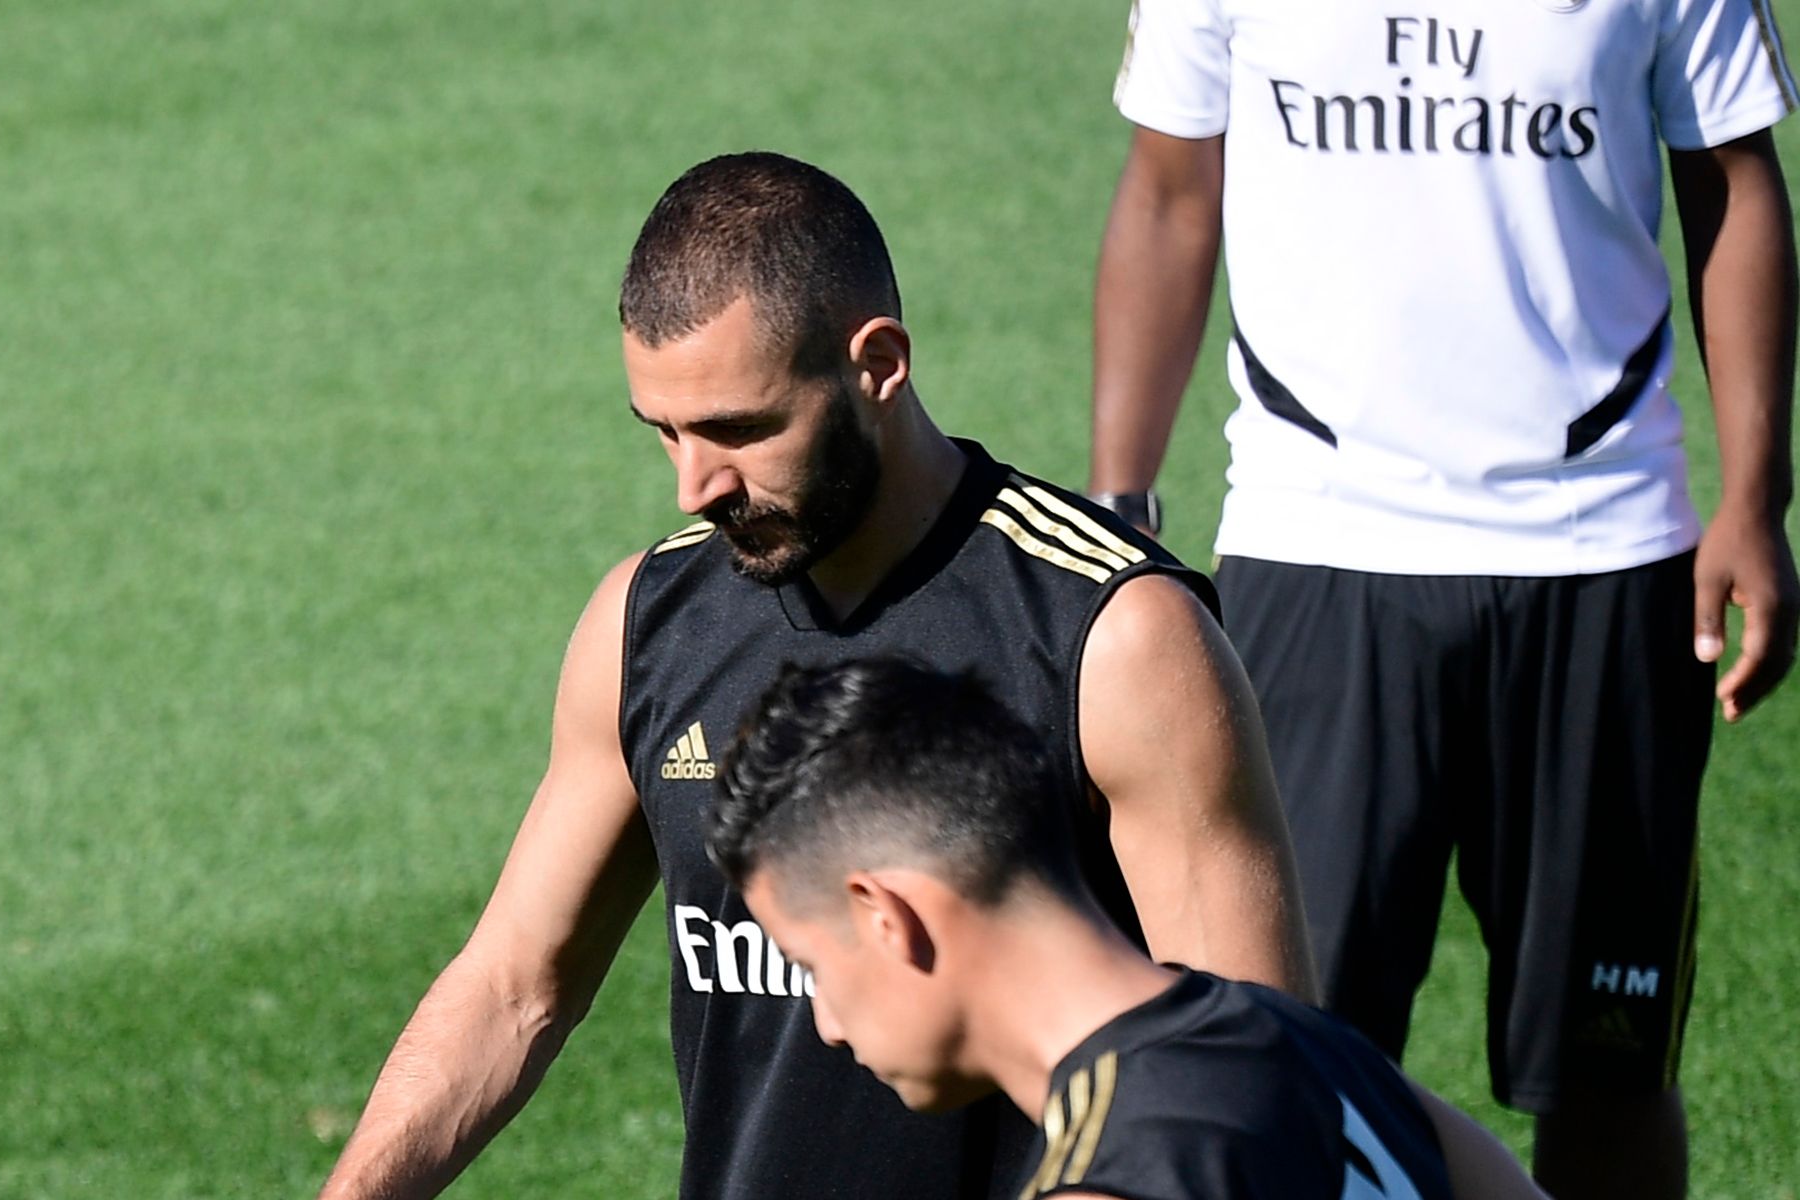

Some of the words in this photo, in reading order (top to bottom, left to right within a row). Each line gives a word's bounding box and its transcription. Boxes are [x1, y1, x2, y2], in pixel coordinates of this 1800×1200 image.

[1386, 16, 1483, 77] Fly
[1270, 78, 1598, 157] Emirates
[661, 759, 716, 780] adidas
